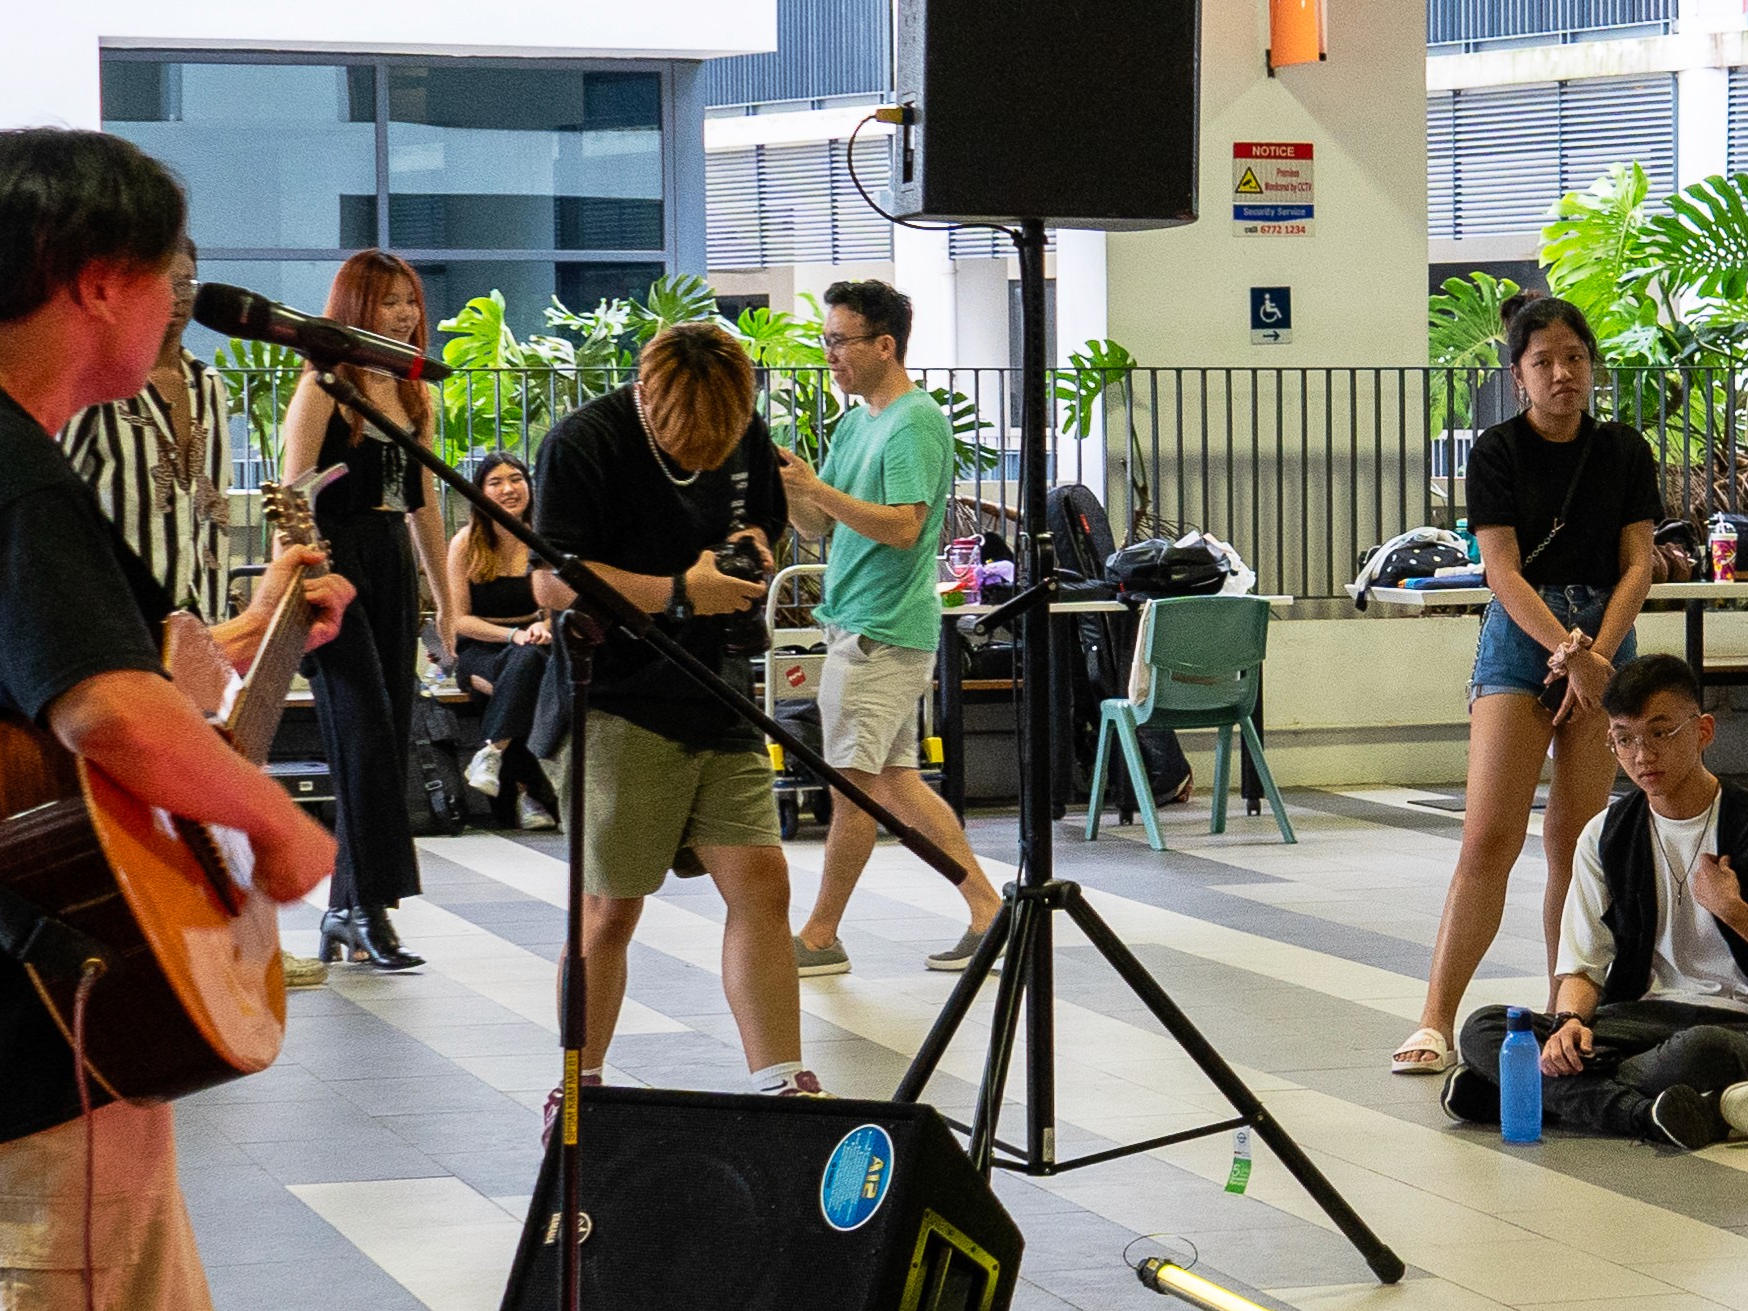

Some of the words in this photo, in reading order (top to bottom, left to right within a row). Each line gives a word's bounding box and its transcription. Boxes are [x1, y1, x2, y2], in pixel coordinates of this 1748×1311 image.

[1252, 145, 1295, 157] NOTICE
[1243, 207, 1275, 217] Security
[1277, 207, 1306, 217] Service
[1260, 225, 1282, 234] 6772
[1285, 225, 1306, 234] 1234
